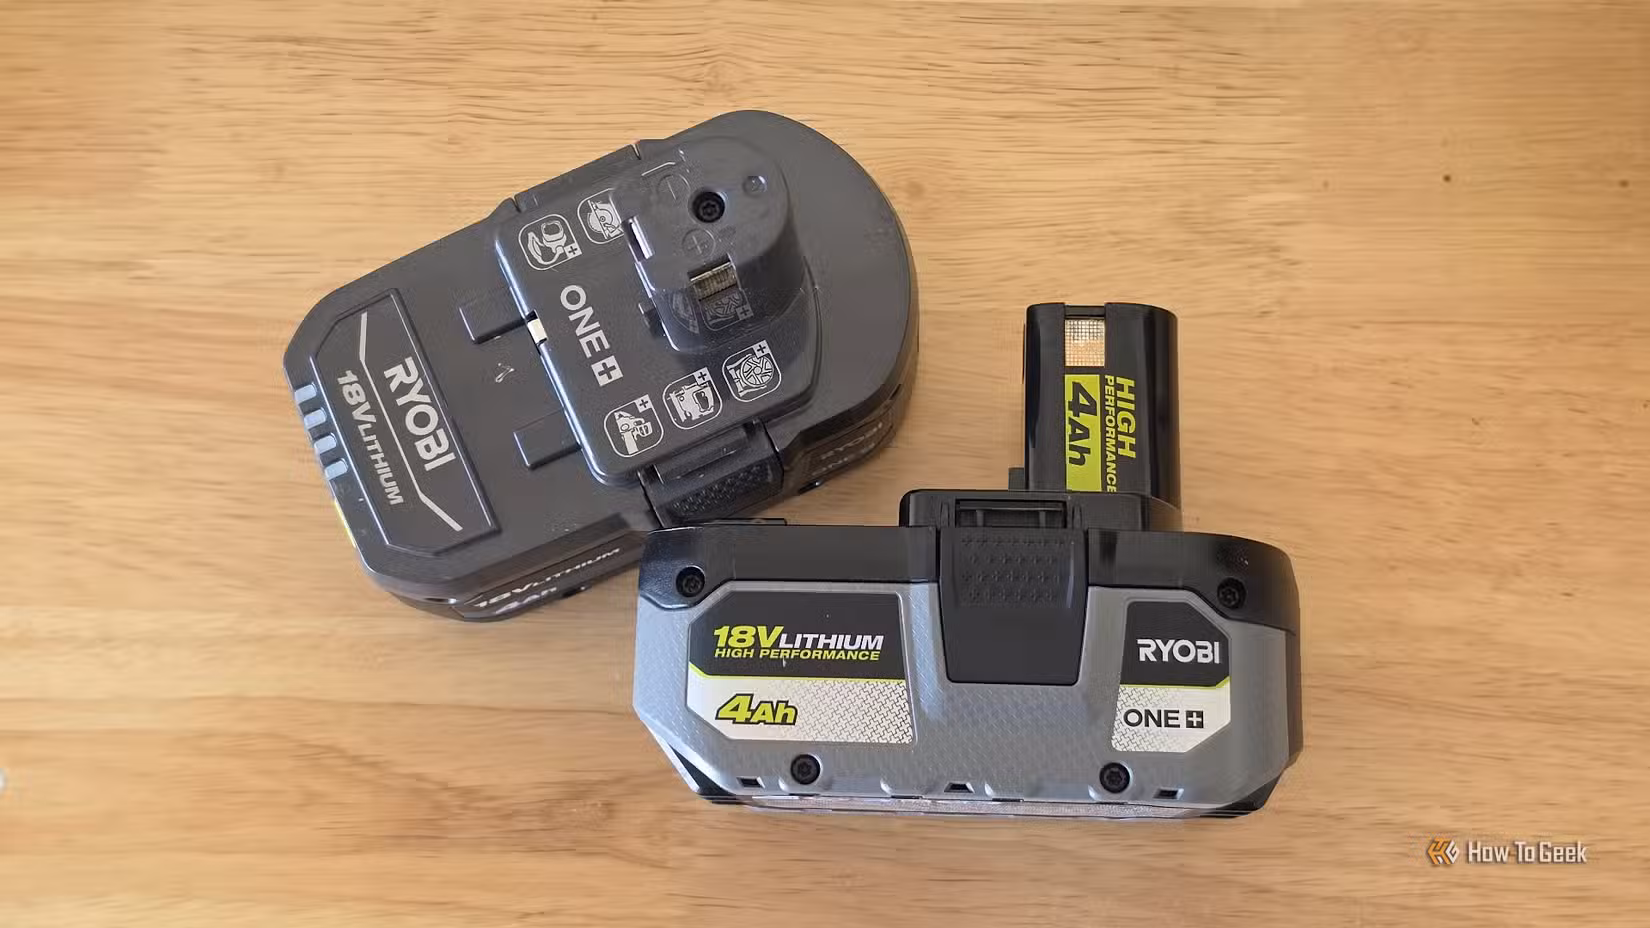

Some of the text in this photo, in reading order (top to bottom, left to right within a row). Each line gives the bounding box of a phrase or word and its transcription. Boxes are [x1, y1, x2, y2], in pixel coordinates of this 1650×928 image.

[383, 356, 457, 472] RYOBI
[1067, 380, 1099, 467] 4Ah
[1104, 374, 1118, 494] PERFORMANCE
[1116, 376, 1137, 459] HIGH
[714, 648, 881, 661] HIGH PERFORMANCE
[1137, 638, 1220, 664] RYOBI
[715, 693, 799, 726] 4Ah
